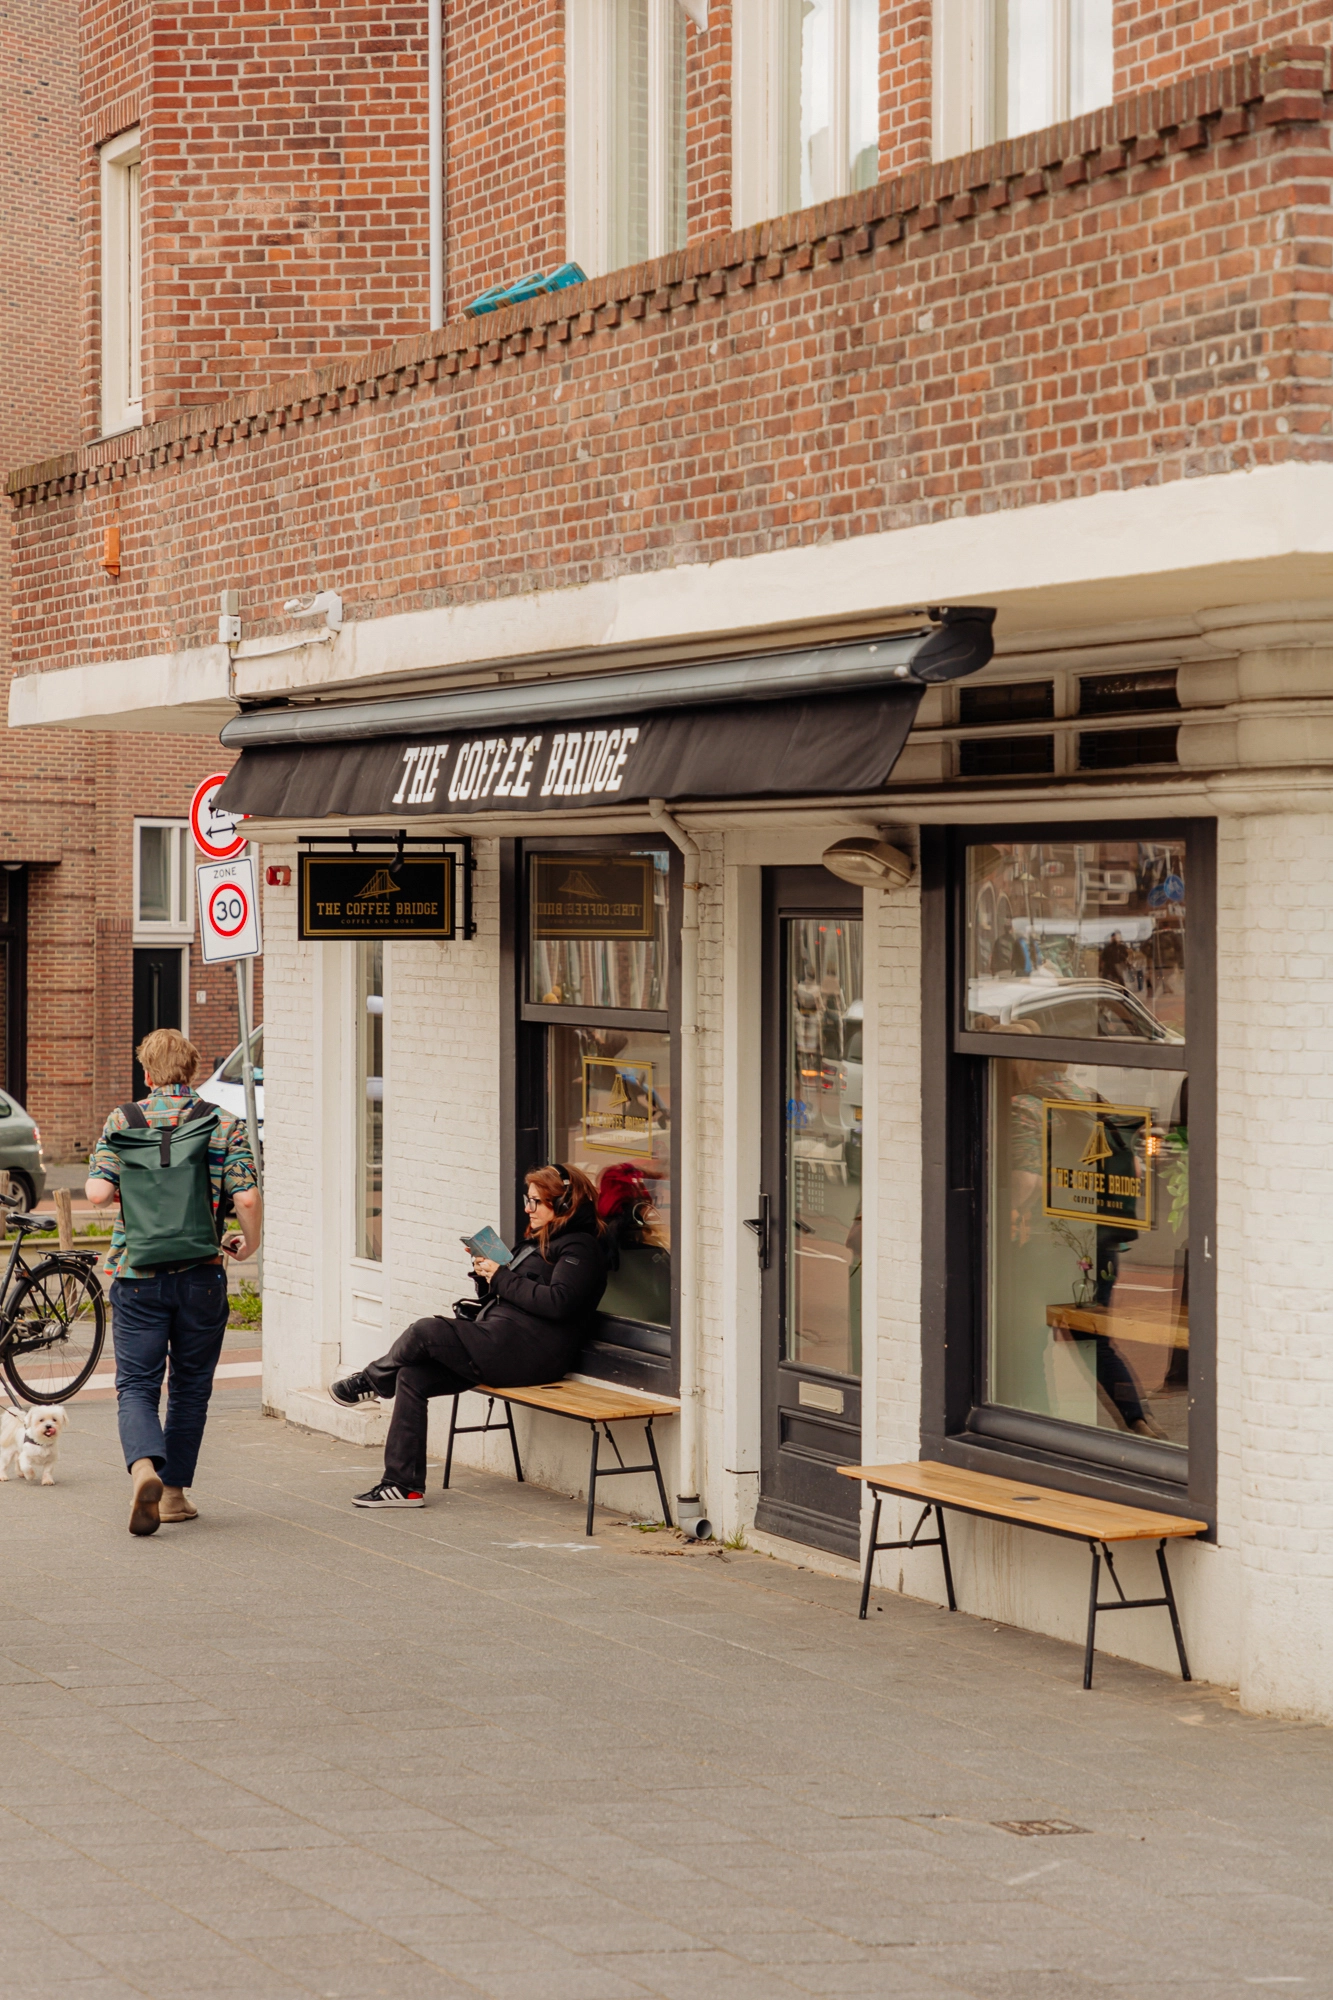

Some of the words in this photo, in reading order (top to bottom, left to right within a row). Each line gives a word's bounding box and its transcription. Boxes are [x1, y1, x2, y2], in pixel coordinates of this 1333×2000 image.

[392, 744, 449, 804] THE
[448, 735, 543, 802] COFFEE
[540, 727, 640, 797] BRIDGE
[213, 866, 237, 879] ZONE
[216, 898, 242, 921] 30
[316, 902, 341, 915] THE
[346, 902, 391, 915] COFFEE
[396, 902, 438, 915] BRIDGE
[1108, 1174, 1142, 1197] BRIDGE
